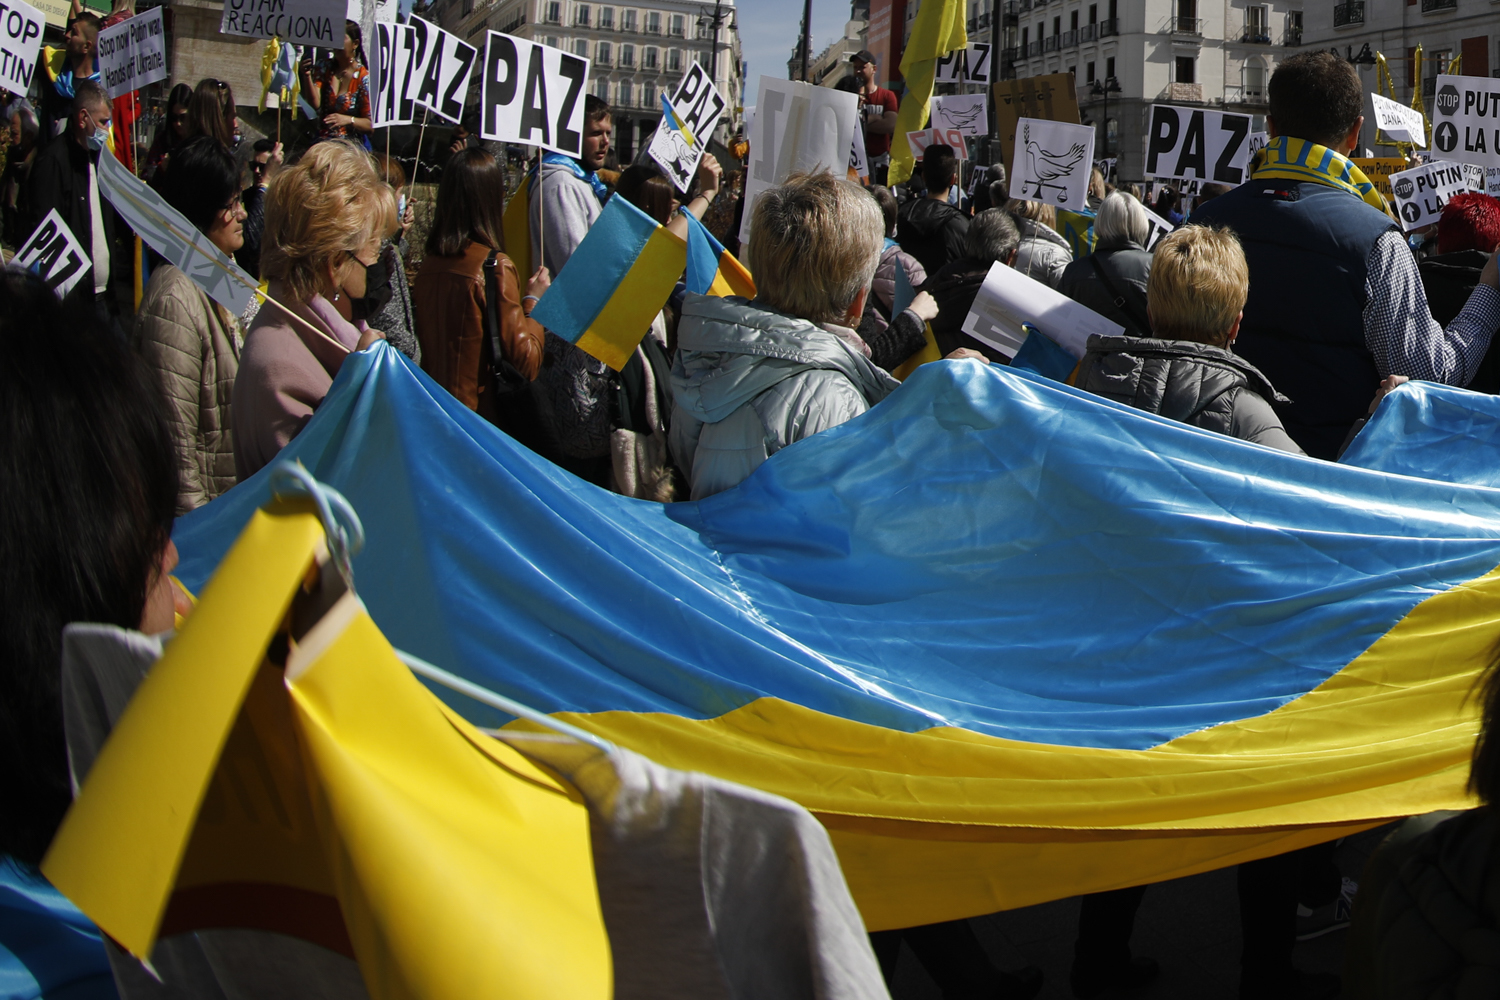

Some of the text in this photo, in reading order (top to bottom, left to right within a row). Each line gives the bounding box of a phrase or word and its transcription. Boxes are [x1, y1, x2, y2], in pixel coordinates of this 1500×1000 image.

[32, 0, 67, 17] CASA DE DIEGO
[99, 18, 162, 59] Stop now Putin war.
[228, 10, 333, 42] REACCIONA
[105, 49, 164, 89] Hands off Ukraine.
[374, 23, 415, 124] PAZ
[408, 16, 476, 121] PAZ
[936, 43, 990, 81] PAZ
[484, 33, 587, 155] PAZ
[672, 63, 725, 151] PAZ
[1437, 93, 1459, 107] STOP
[1382, 112, 1402, 125] DAÑA
[1146, 105, 1250, 185] PAZ
[1465, 126, 1487, 153] LA
[1376, 162, 1391, 175] Putin
[1395, 182, 1413, 195] STOP
[1415, 165, 1463, 193] PUTIN
[1463, 164, 1482, 176] STOP
[1466, 177, 1480, 190] UTIN
